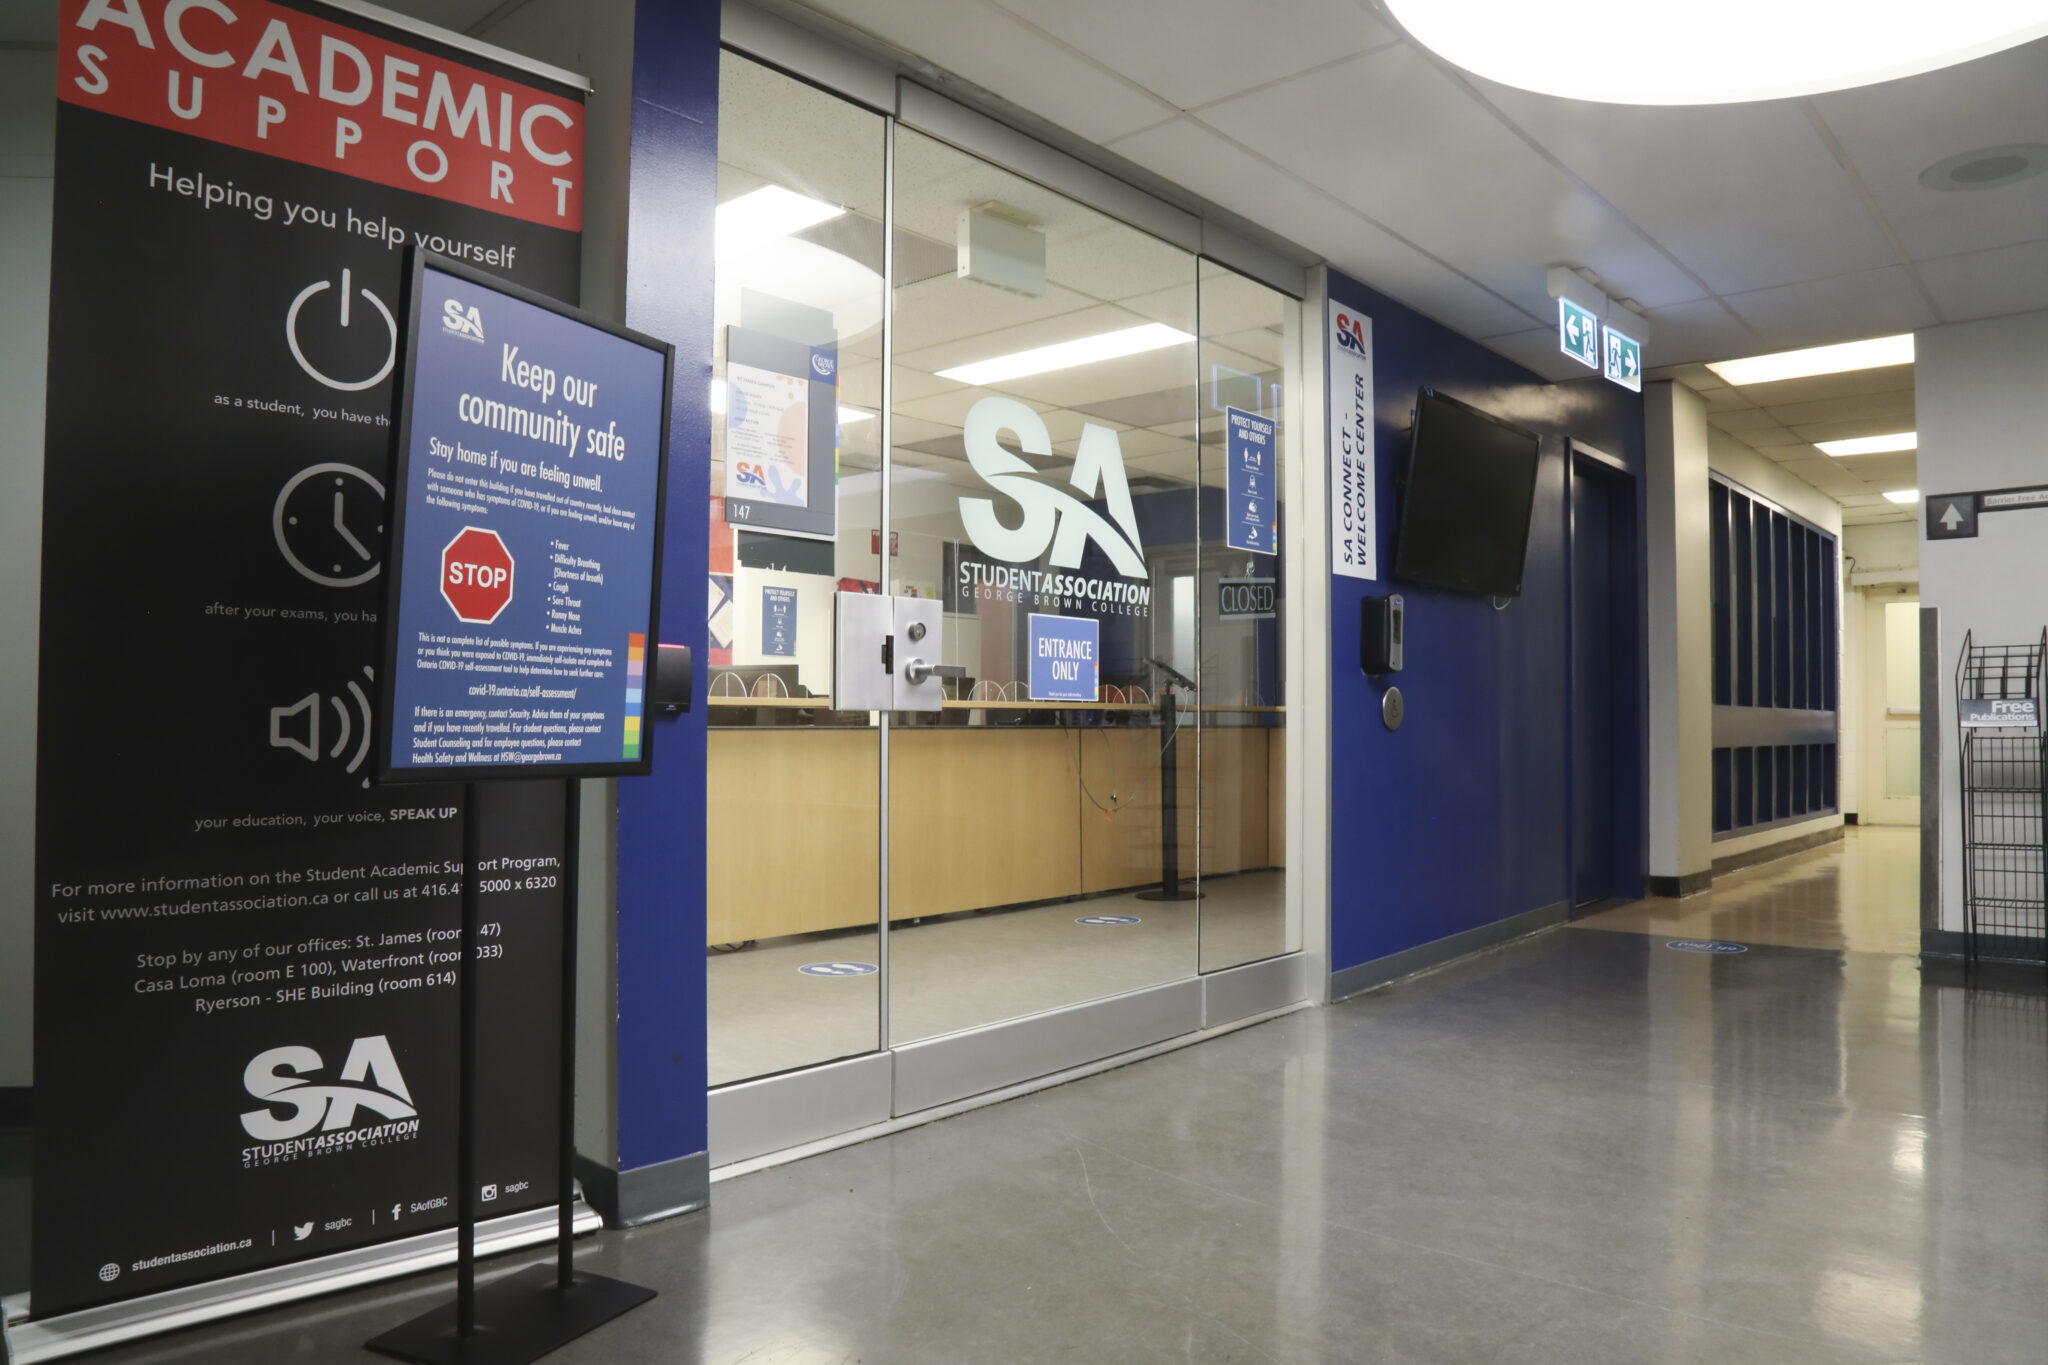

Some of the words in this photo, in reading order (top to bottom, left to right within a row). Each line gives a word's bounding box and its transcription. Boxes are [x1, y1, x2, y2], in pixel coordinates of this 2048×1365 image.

[75, 0, 575, 166] ACADEMIC
[74, 44, 573, 217] SUPPORT
[149, 162, 273, 220] Helping
[283, 199, 336, 228] you
[347, 208, 405, 246] help
[414, 231, 517, 269] yourself
[442, 299, 484, 338] SA
[1337, 312, 1365, 355] SA
[501, 343, 556, 403] Keep
[563, 375, 598, 407] our
[214, 395, 229, 405] as
[233, 397, 242, 407] a
[246, 399, 304, 417] student,
[312, 407, 337, 419] you
[341, 408, 372, 424] have
[375, 413, 390, 427] th
[1231, 414, 1251, 429] PROTECT
[1251, 419, 1272, 435] YOURSELF
[1355, 373, 1364, 458] CENTER
[458, 393, 581, 458] community
[586, 421, 625, 461] safe
[1238, 428, 1249, 440] AND
[1249, 432, 1266, 445] OTHERS
[429, 436, 454, 463] Stay
[456, 441, 487, 466] home
[490, 449, 498, 468] if
[499, 457, 517, 474] you
[520, 462, 536, 477] are
[539, 460, 570, 488] feeling
[572, 474, 602, 492] unwell.
[958, 396, 1148, 579] SA
[1343, 426, 1352, 532] CONNECT
[733, 504, 750, 520] 147
[1356, 461, 1366, 566] WELCOME
[1986, 495, 2015, 505] Barrier
[555, 539, 569, 550] Fever
[1344, 539, 1353, 565] SA
[449, 561, 507, 589] STOP
[553, 567, 579, 580] (Shortness
[579, 571, 585, 580] of
[585, 571, 603, 585] breath)
[554, 553, 576, 567] Difficulty
[577, 557, 600, 571] Breathing
[552, 581, 568, 594] Cough
[960, 561, 1150, 606] STUDENTASSOCIATION
[204, 601, 240, 615] after
[244, 607, 276, 619] your
[280, 609, 327, 621] exams,
[333, 612, 357, 623] you
[361, 609, 377, 622] ha
[552, 594, 564, 605] Sore
[564, 596, 581, 607] Throat
[962, 586, 1024, 603] GEORGE
[1034, 595, 1082, 611] BROWN
[1092, 602, 1149, 617] COLLEGE
[1221, 585, 1274, 612] CLOSED
[550, 622, 567, 633] Muscle
[567, 624, 582, 635] Aches
[551, 609, 567, 621] Runny
[567, 610, 580, 621] Nose
[1038, 637, 1092, 660] ENTRANCE
[1052, 660, 1079, 681] ONLY
[468, 683, 577, 699] covid-19.ontario.ca/self-assessment/
[1970, 713, 2034, 721] Publications
[1991, 700, 2034, 713] Free
[413, 721, 426, 732] and
[427, 721, 433, 732] if
[433, 724, 445, 734] you
[446, 721, 461, 732] have
[462, 722, 484, 734] recently
[485, 722, 511, 732] travelled.
[512, 722, 522, 732] For
[522, 722, 542, 732] student
[542, 723, 567, 734] questions,
[568, 723, 584, 734] please
[584, 724, 601, 733] contact
[412, 736, 437, 748] Student
[438, 737, 470, 749] Counseling
[471, 736, 483, 747] and
[484, 736, 493, 747] for
[493, 737, 520, 749] employee
[520, 737, 546, 748] questions,
[547, 737, 563, 748] please
[564, 738, 581, 746] contact
[412, 752, 433, 763] Health
[434, 751, 454, 764] Safety
[454, 751, 467, 762] and
[468, 751, 492, 762] Wellness
[493, 753, 499, 761] at
[500, 750, 561, 763] HSW@georgebrown.ca
[194, 818, 228, 832] your
[232, 813, 306, 827] education,
[313, 814, 343, 827] your
[347, 810, 384, 822] voice,
[389, 807, 435, 820] SPEAK
[438, 807, 457, 818] UP
[52, 883, 82, 897] For
[88, 882, 135, 895] more
[141, 873, 243, 891] information
[249, 872, 270, 885] on
[274, 869, 301, 883] the
[306, 866, 365, 881] Student
[370, 861, 439, 877] Academic
[443, 858, 497, 875] Suort
[501, 857, 560, 871] Program,
[57, 907, 95, 923] visit
[100, 893, 328, 920] www.studentassociation.ca
[333, 892, 349, 903] or
[353, 887, 378, 901] call
[383, 889, 398, 899] us
[402, 886, 417, 898] at
[514, 880, 522, 889] x
[525, 875, 556, 889] 6320
[137, 954, 176, 968] Stop
[182, 949, 202, 966] by
[207, 949, 237, 963] any
[242, 943, 260, 958] of
[264, 944, 292, 956] our
[297, 937, 351, 953] offices:
[356, 934, 374, 948] St.
[378, 932, 422, 945] James
[480, 921, 500, 936] 47)
[134, 979, 173, 993] Casa
[180, 974, 225, 989] Loma
[231, 969, 280, 985] (room
[285, 964, 294, 978] E
[300, 960, 336, 976] 100),
[341, 953, 424, 972] Waterfront
[195, 995, 260, 1014] Ryerson
[276, 987, 305, 1003] SHE
[311, 981, 373, 999] Building
[378, 977, 421, 993] (room
[426, 970, 456, 986] 614)
[239, 1034, 418, 1141] SA
[241, 1119, 419, 1162] STUDENTASSOCIATION
[243, 1152, 299, 1169] GEORGE
[307, 1143, 353, 1158] BROWN
[361, 1131, 418, 1148] COLLEGE
[131, 1237, 252, 1272] studentassociation.ca
[324, 1216, 352, 1232] sagbc
[410, 1196, 448, 1214] SAofGBC
[504, 1179, 529, 1195] sagbc
